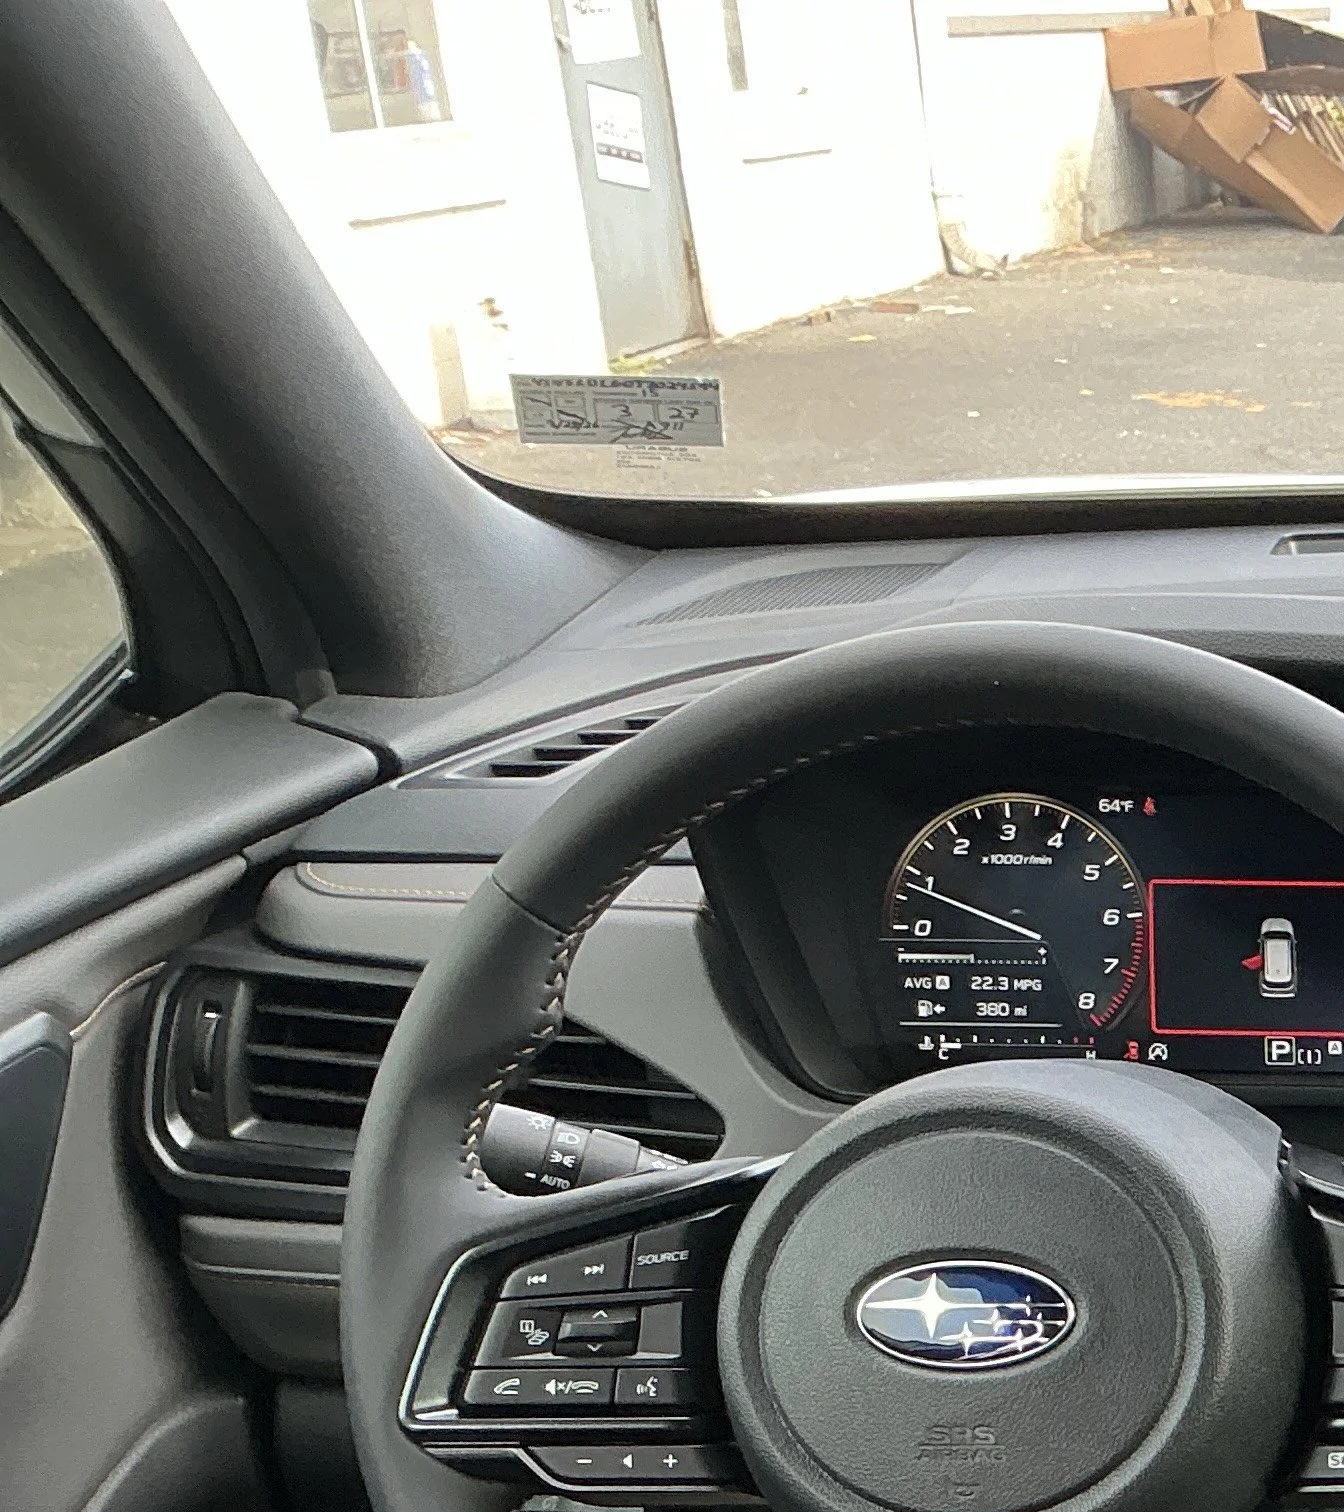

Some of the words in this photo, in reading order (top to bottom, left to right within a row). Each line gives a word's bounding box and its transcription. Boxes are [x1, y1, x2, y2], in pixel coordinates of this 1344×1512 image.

[1000, 824, 1017, 841] 3
[1047, 833, 1063, 849] 4
[953, 838, 971, 855] 2
[1083, 865, 1100, 881] 5
[1103, 909, 1121, 926] 6
[914, 919, 932, 936] 0
[1103, 958, 1119, 974] 7
[904, 977, 932, 990] AVG
[971, 976, 1009, 991] 22.3
[1013, 978, 1042, 991] MPG
[976, 1002, 1010, 1016] 380
[1014, 1004, 1028, 1016] mi
[1078, 992, 1095, 1010] 8
[937, 1049, 949, 1060] C
[1271, 1041, 1291, 1061] P
[540, 1174, 571, 1191] AUTO
[636, 1249, 690, 1267] SOURCE
